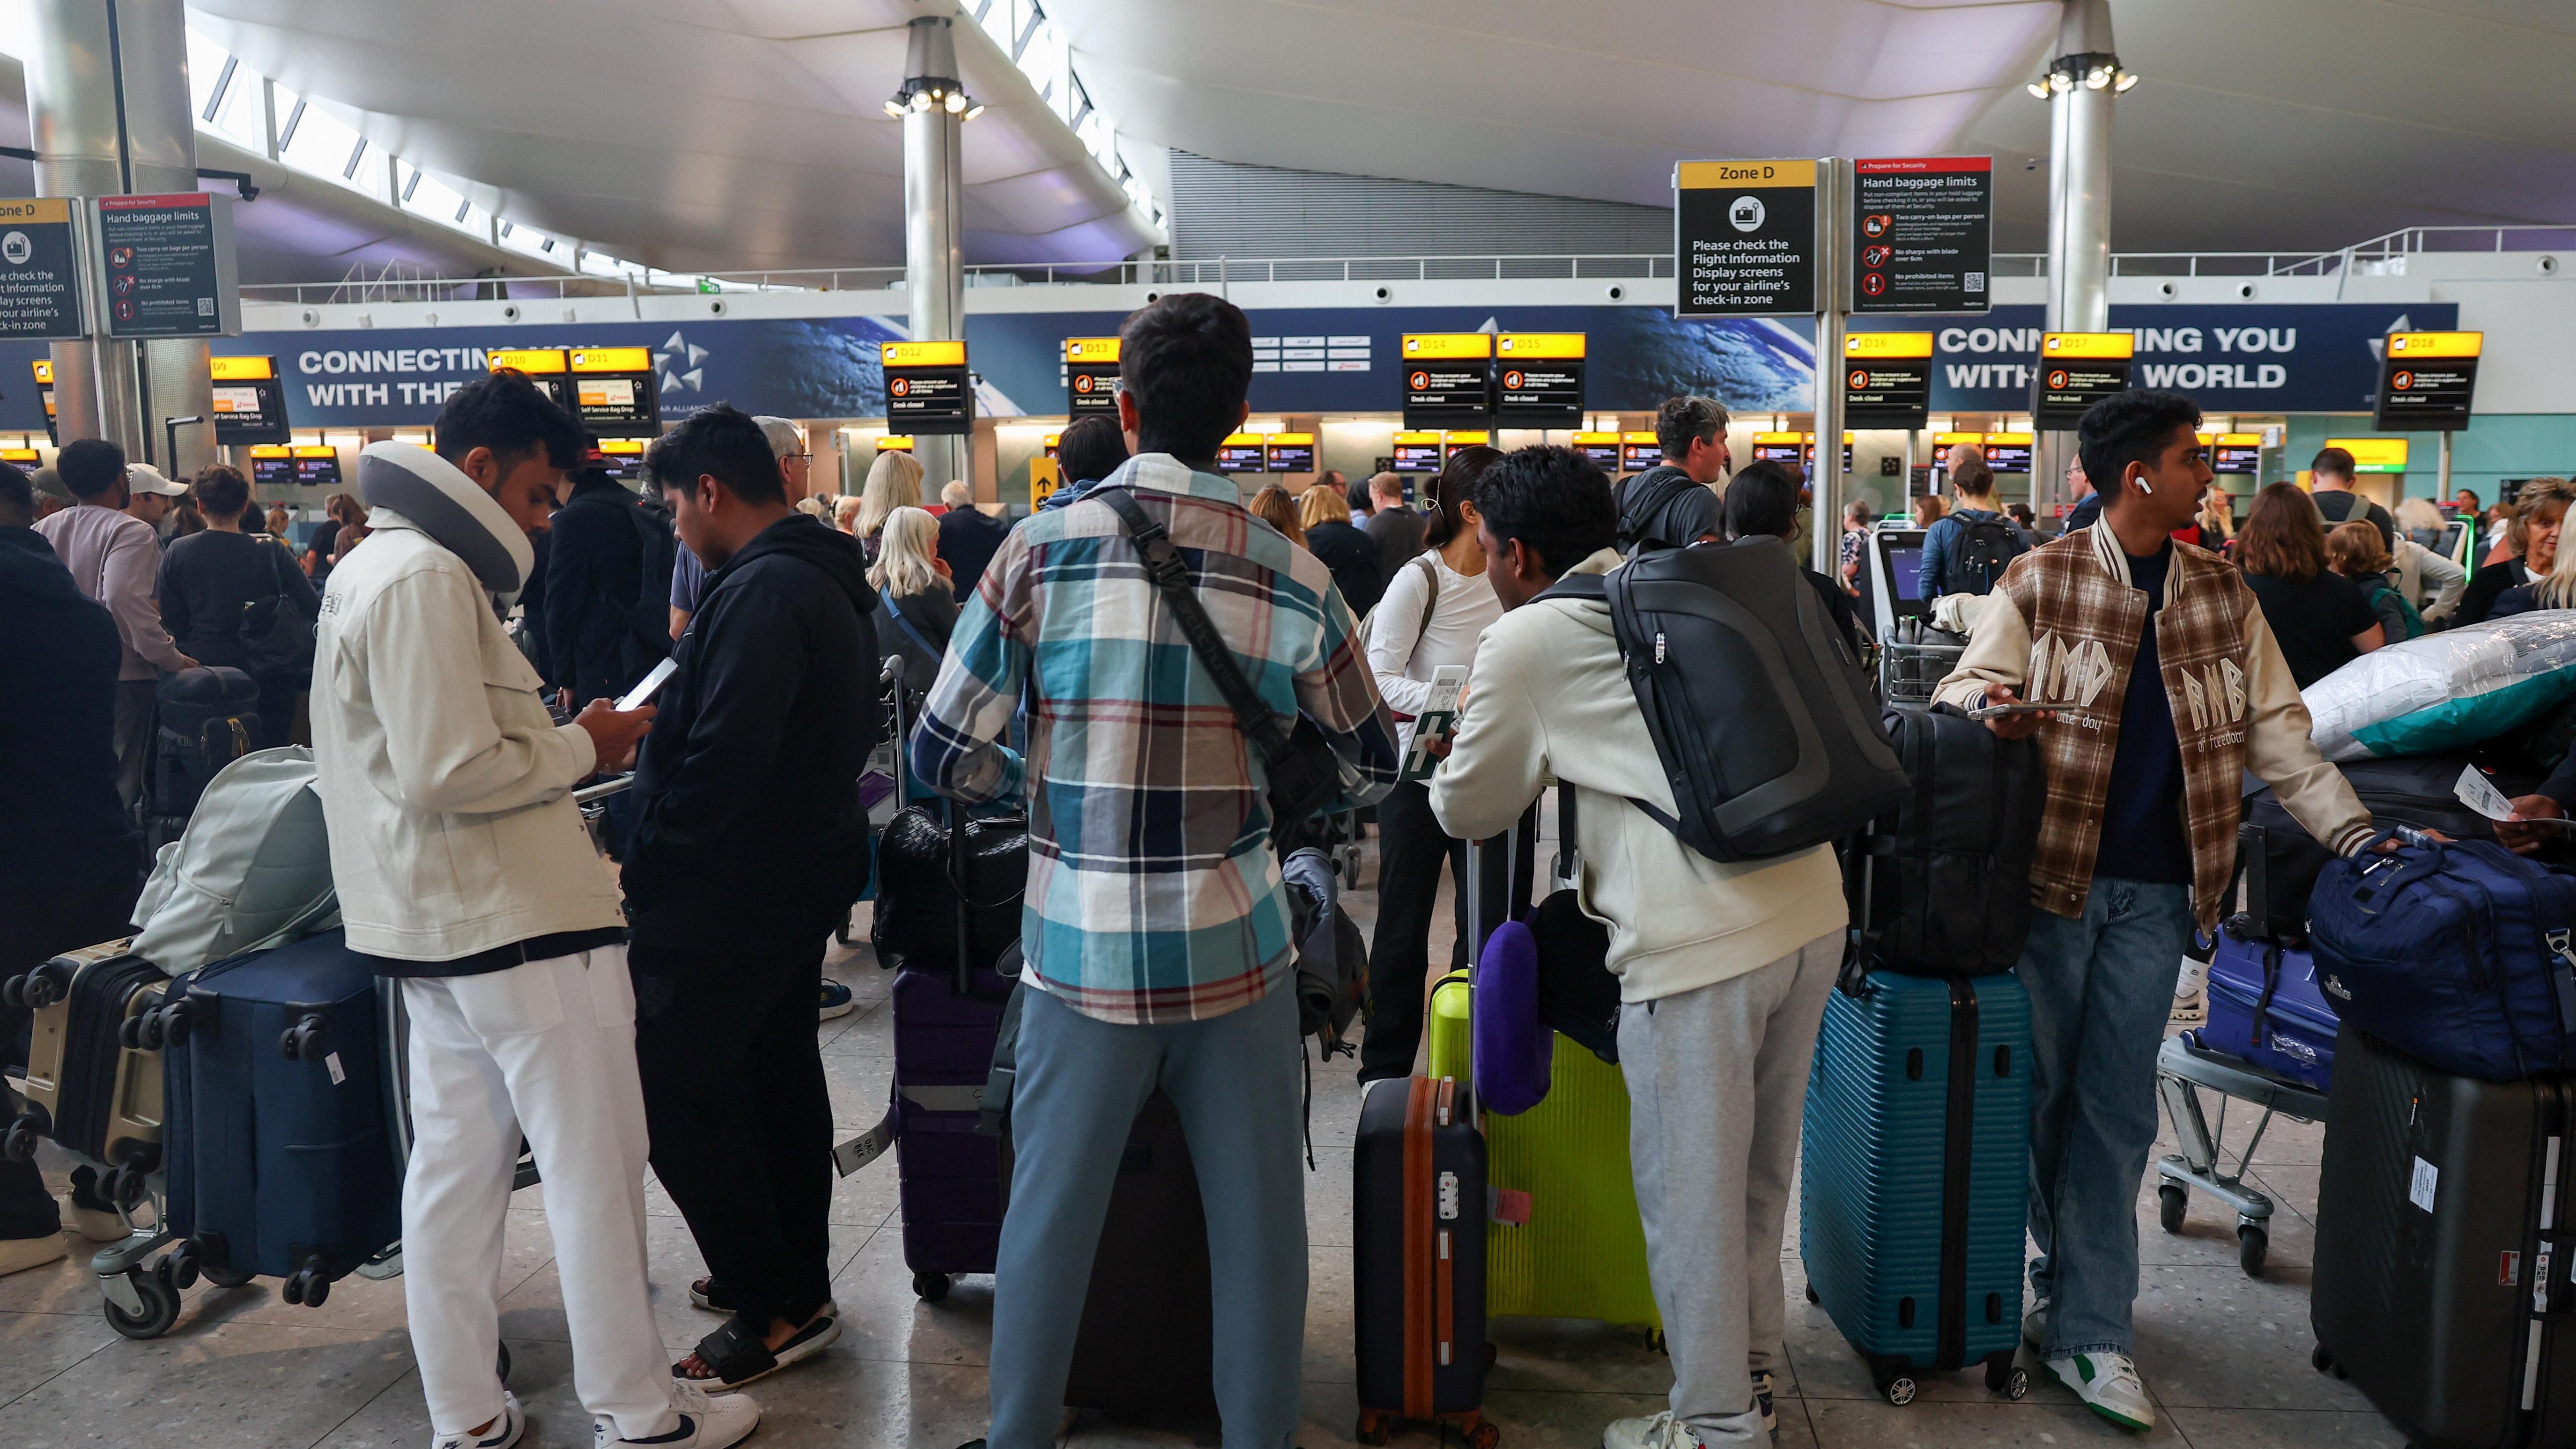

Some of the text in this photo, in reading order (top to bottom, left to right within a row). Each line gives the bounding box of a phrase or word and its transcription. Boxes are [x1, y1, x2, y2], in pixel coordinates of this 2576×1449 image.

[1720, 167, 1774, 179] Zone D
[1863, 176, 1977, 189] Hand baggage limits
[0, 204, 35, 216] one D
[107, 211, 199, 224] Hand baggage limits
[1693, 239, 1789, 251] Please check the
[1693, 252, 1800, 266] Flight Information
[8, 271, 36, 281] check
[38, 271, 53, 280] the
[1693, 267, 1784, 280] Display screens
[7, 283, 64, 293] Information
[1693, 281, 1710, 291] for
[1713, 283, 1741, 294] your
[16, 296, 52, 305] screens
[1693, 294, 1773, 305] check-in zone
[23, 321, 46, 330] zone
[1424, 340, 1445, 348] D14
[1518, 340, 1540, 348] D15
[1865, 339, 1887, 347] D16
[2065, 339, 2087, 347] D17
[2212, 327, 2296, 352] YOU
[901, 347, 921, 356] D12
[1087, 344, 1108, 352] D13
[299, 347, 517, 374] CONNECTIN
[588, 354, 608, 362] D11
[213, 362, 226, 371] D9
[2143, 364, 2287, 389] WORLD
[307, 383, 389, 407] WITH
[239, 412, 249, 421] Bag
[2082, 717, 2102, 735] day
[2198, 731, 2245, 753] of freedom
[855, 1143, 865, 1159] BKK
[865, 1138, 873, 1154] DAC
